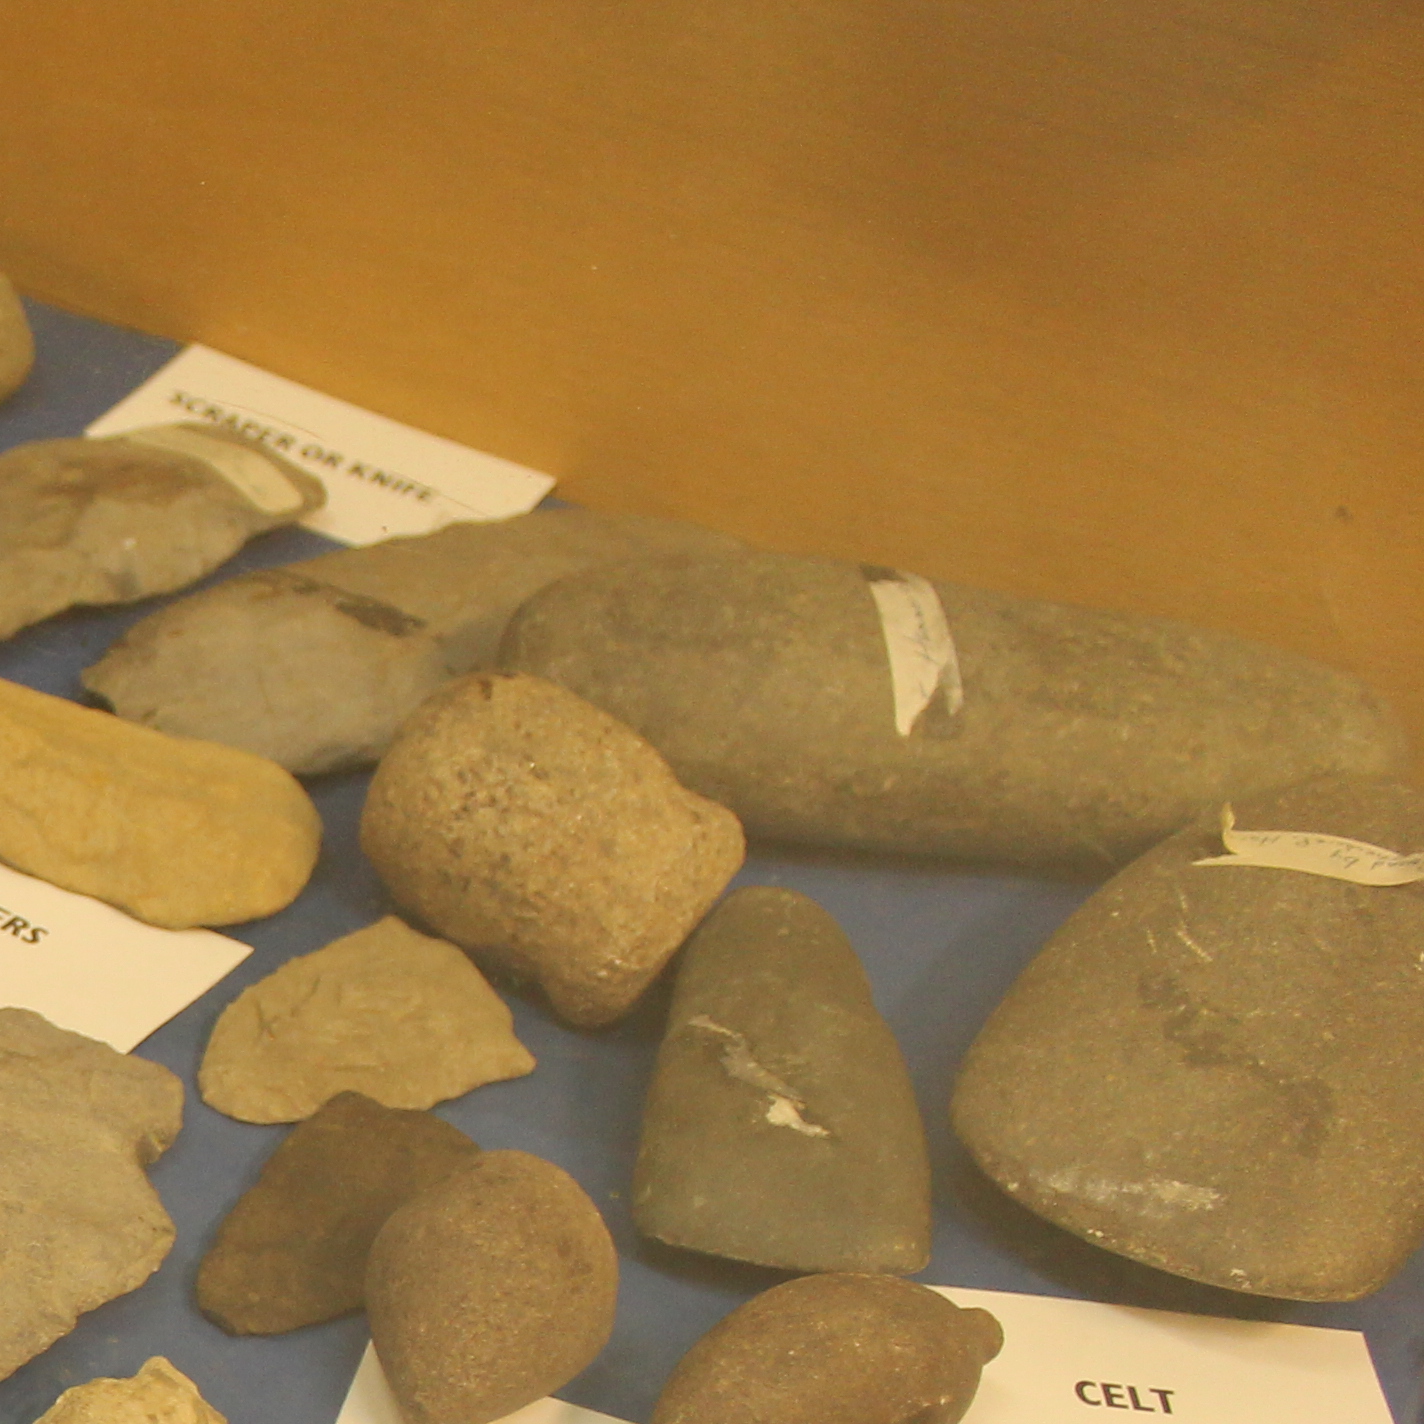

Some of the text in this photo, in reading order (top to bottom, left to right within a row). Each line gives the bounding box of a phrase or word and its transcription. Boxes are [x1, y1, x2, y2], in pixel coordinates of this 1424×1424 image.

[169, 389, 434, 503] SCRAPER OR KNIFE
[1073, 1378, 1175, 1417] CELT
